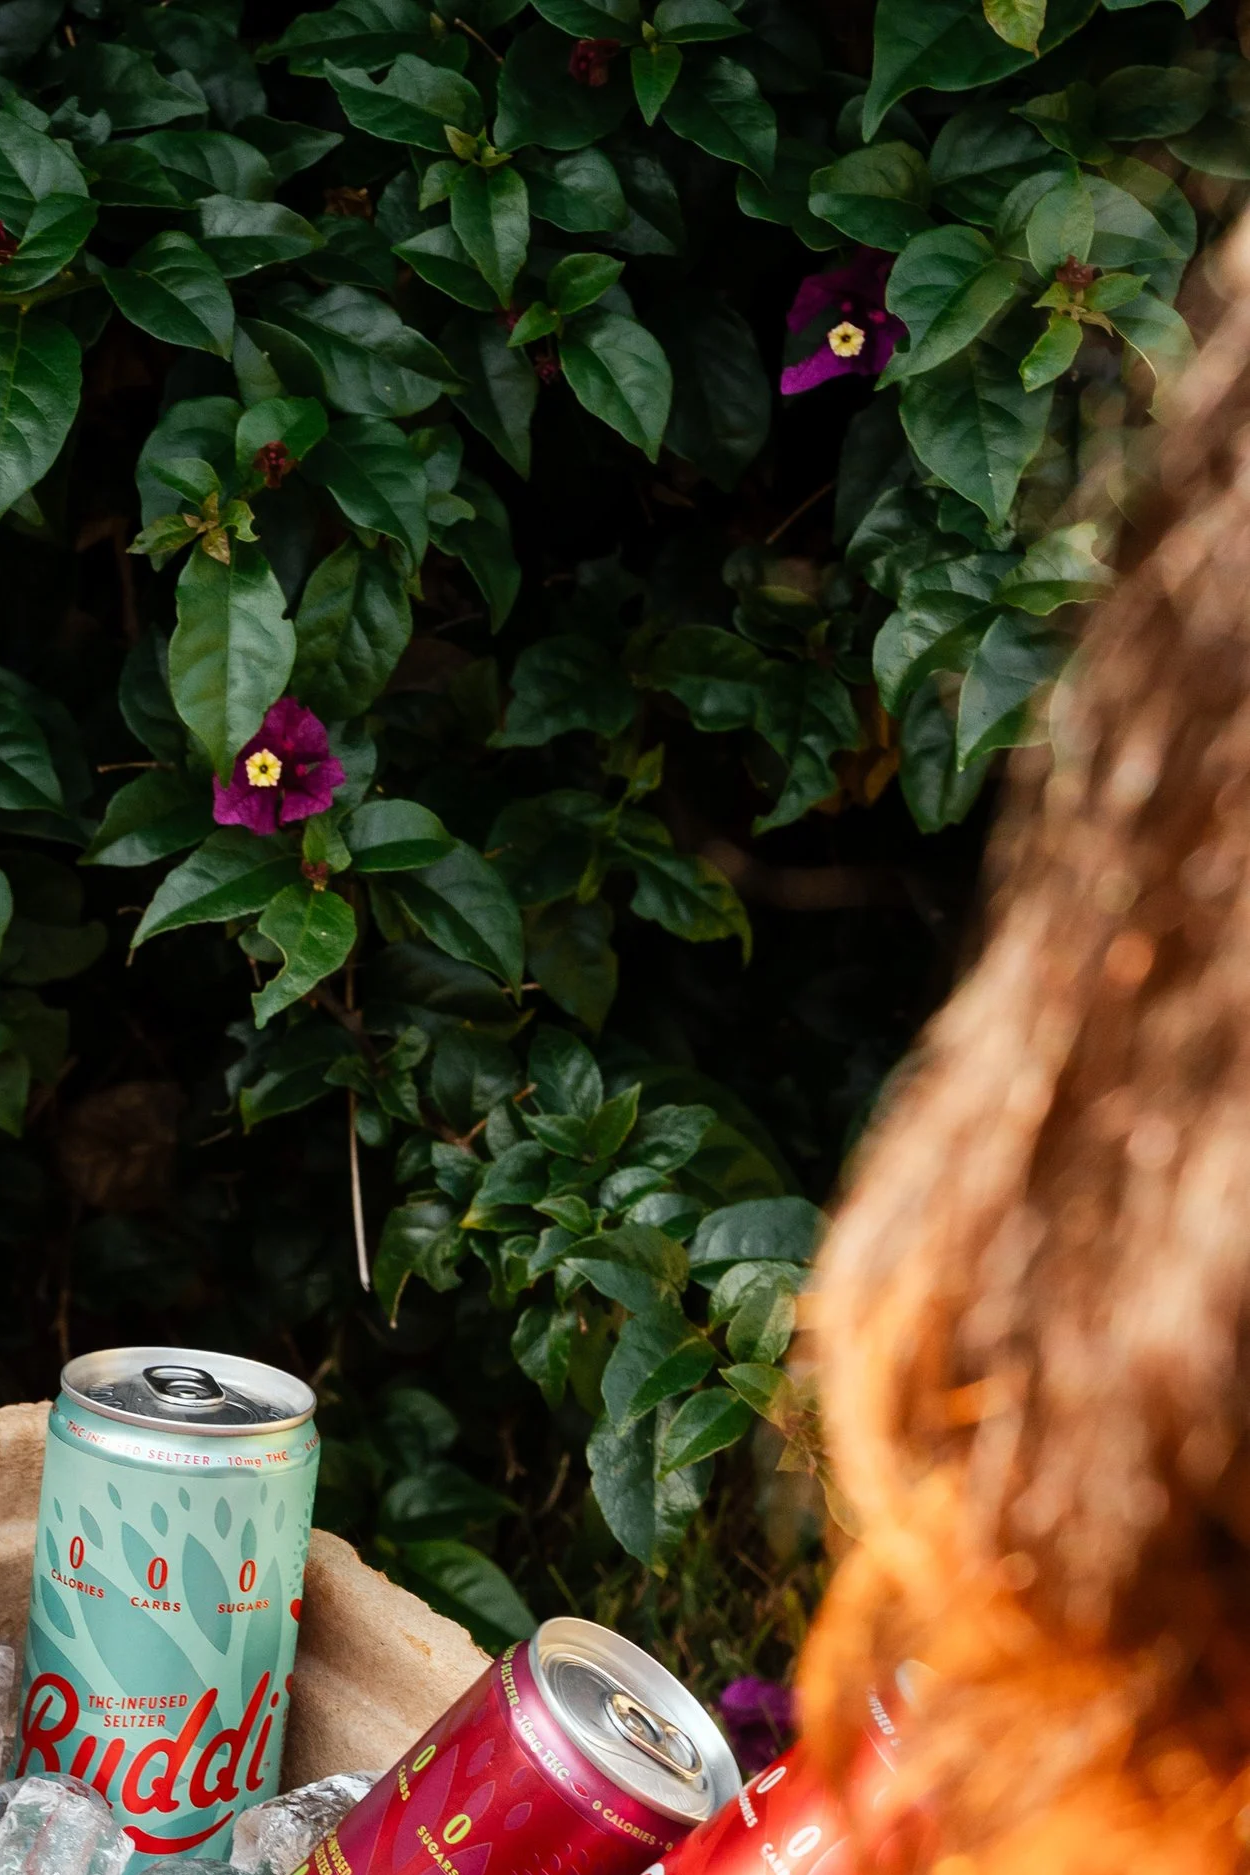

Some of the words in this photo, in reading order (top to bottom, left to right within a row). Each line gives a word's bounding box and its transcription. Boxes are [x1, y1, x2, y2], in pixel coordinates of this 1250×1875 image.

[147, 1448, 210, 1466] SELTZER
[227, 1456, 262, 1468] 10mg
[264, 1450, 289, 1464] THC
[68, 1535, 85, 1570] 0
[50, 1568, 105, 1599] CALORIES
[147, 1557, 168, 1590] 0
[238, 1559, 256, 1593] 0
[130, 1596, 182, 1613] CARBS
[217, 1599, 270, 1614] SUGARS
[88, 1694, 189, 1711] THC-INFUSED
[103, 1713, 167, 1728] SELTZER
[500, 1660, 520, 1707] SELTZER
[518, 1714, 545, 1753] 10mg
[540, 1749, 572, 1781] THC
[411, 1744, 437, 1773] 0
[756, 1766, 787, 1794] 0
[442, 1813, 473, 1844] 0
[591, 1800, 602, 1811] 0
[602, 1808, 656, 1847] CALORIES
[787, 1825, 822, 1858] 0
